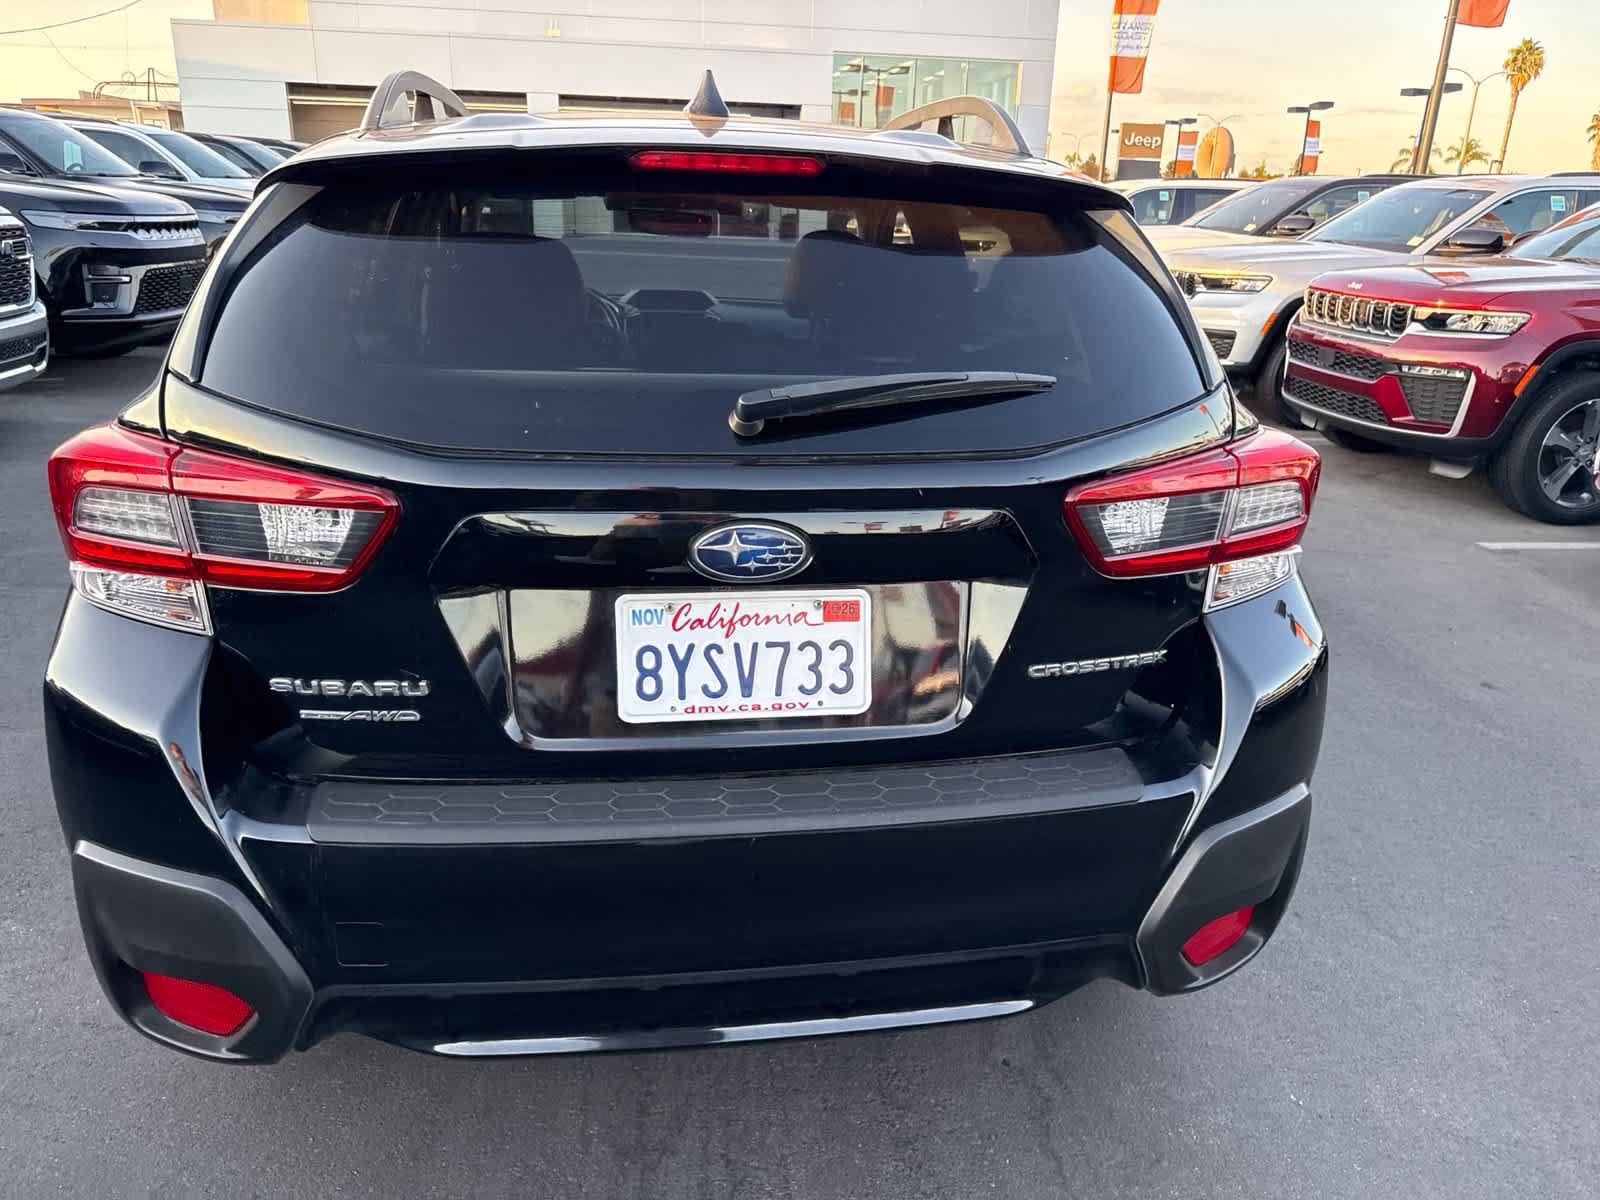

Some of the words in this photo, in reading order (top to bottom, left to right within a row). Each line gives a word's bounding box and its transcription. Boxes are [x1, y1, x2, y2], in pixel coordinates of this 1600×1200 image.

[1124, 132, 1161, 149] Jeep
[631, 608, 664, 626] NOV
[671, 602, 824, 639] California
[635, 639, 854, 702] 8YSV733
[1028, 649, 1168, 678] CROSSTREK
[269, 677, 429, 696] SUBARU
[345, 710, 420, 721] AWD
[684, 701, 809, 714] dmv.ca.gov
